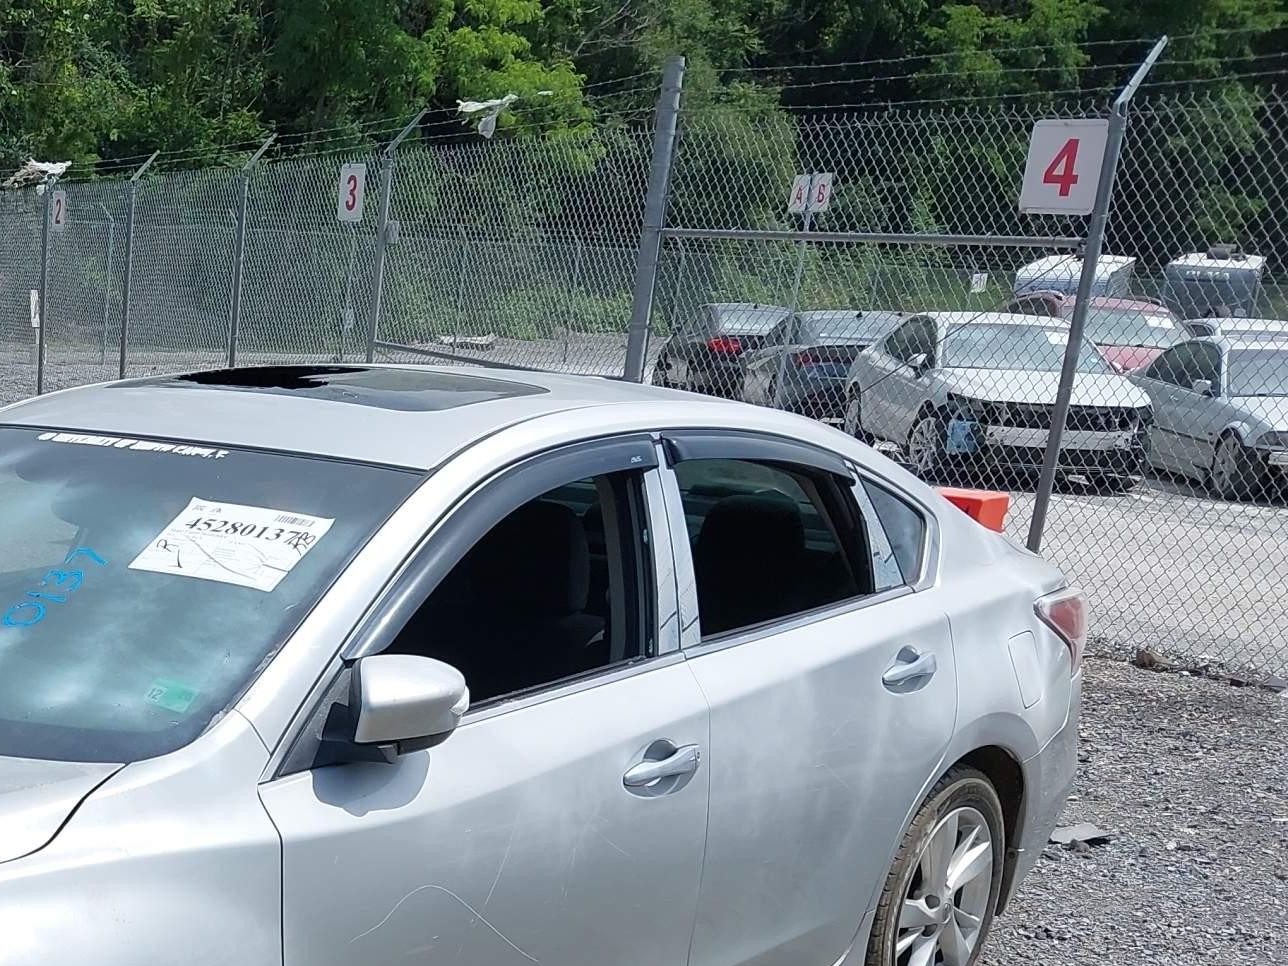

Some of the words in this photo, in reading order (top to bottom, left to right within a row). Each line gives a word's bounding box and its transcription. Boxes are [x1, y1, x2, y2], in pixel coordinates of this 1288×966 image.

[1042, 138, 1080, 196] 4
[345, 174, 358, 211] 3
[54, 198, 62, 225] 2
[185, 516, 302, 545] 45280137
